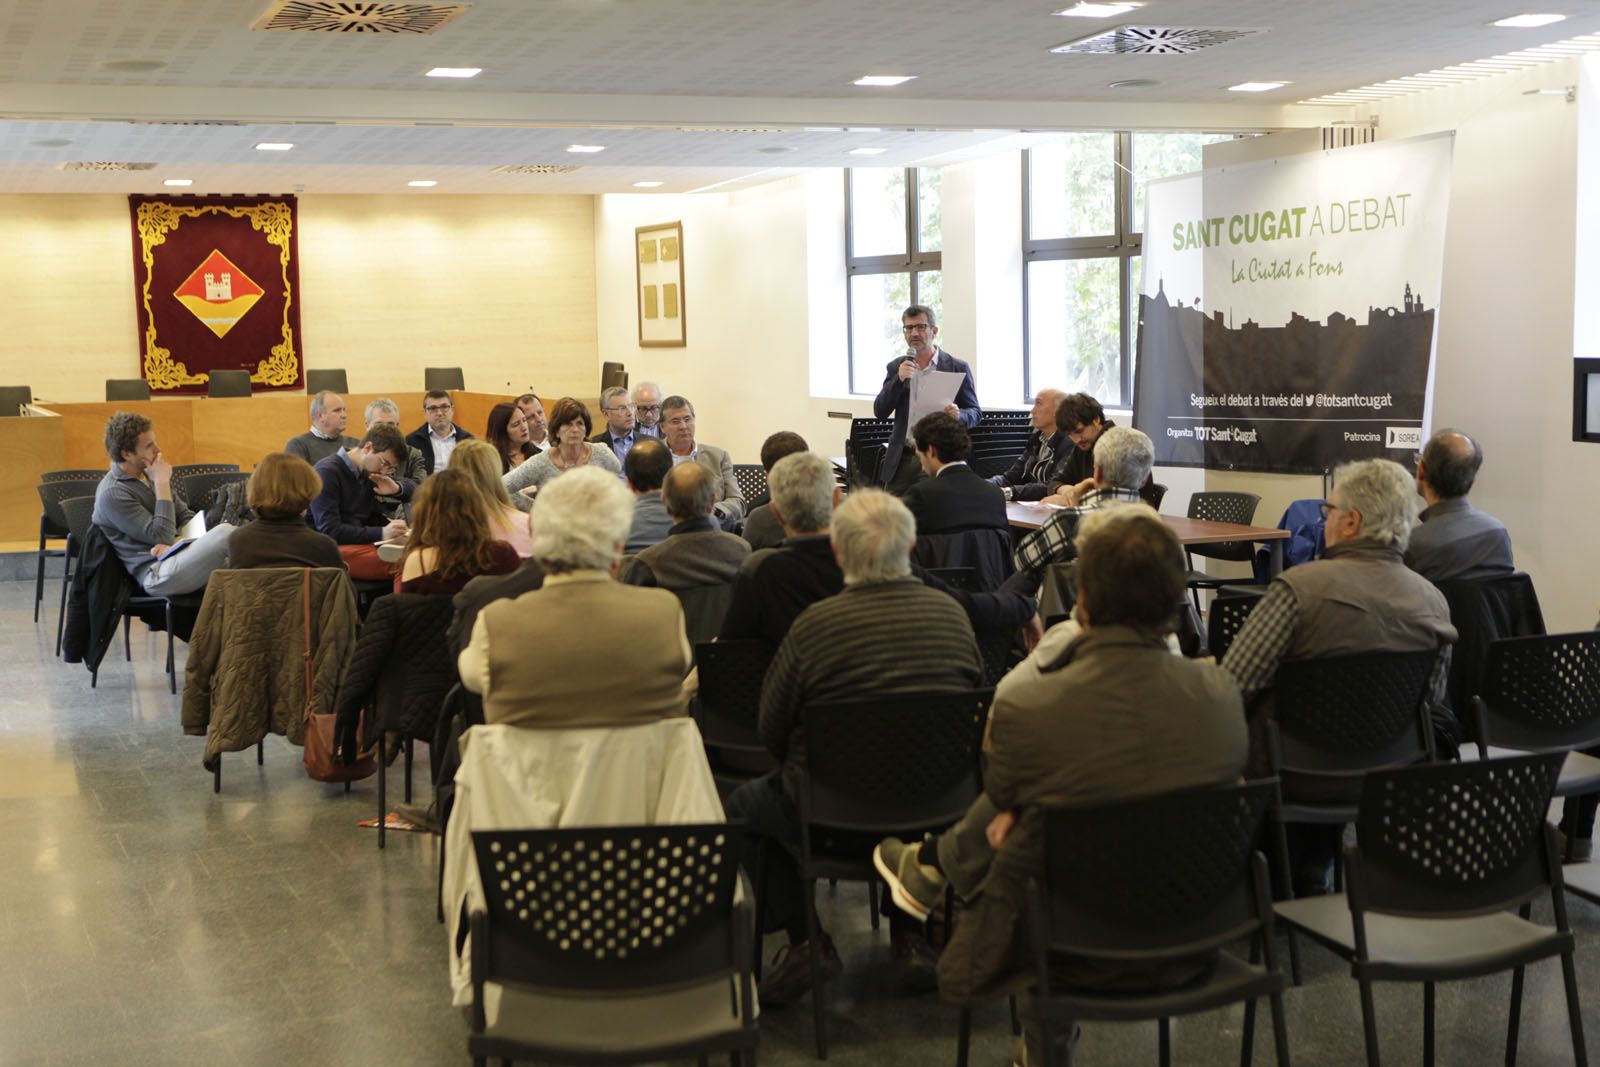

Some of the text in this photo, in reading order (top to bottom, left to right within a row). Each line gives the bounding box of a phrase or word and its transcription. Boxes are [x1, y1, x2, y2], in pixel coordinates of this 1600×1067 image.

[1172, 194, 1411, 252] SANT CUGAT A DEBAT
[1231, 251, 1344, 284] La Ciutat a Fons
[1190, 393, 1392, 410] Segueix el debat a través del @totsantcugat
[1167, 426, 1257, 445] Organitza TOT Sant Cugat
[1344, 431, 1381, 442] Patrocina
